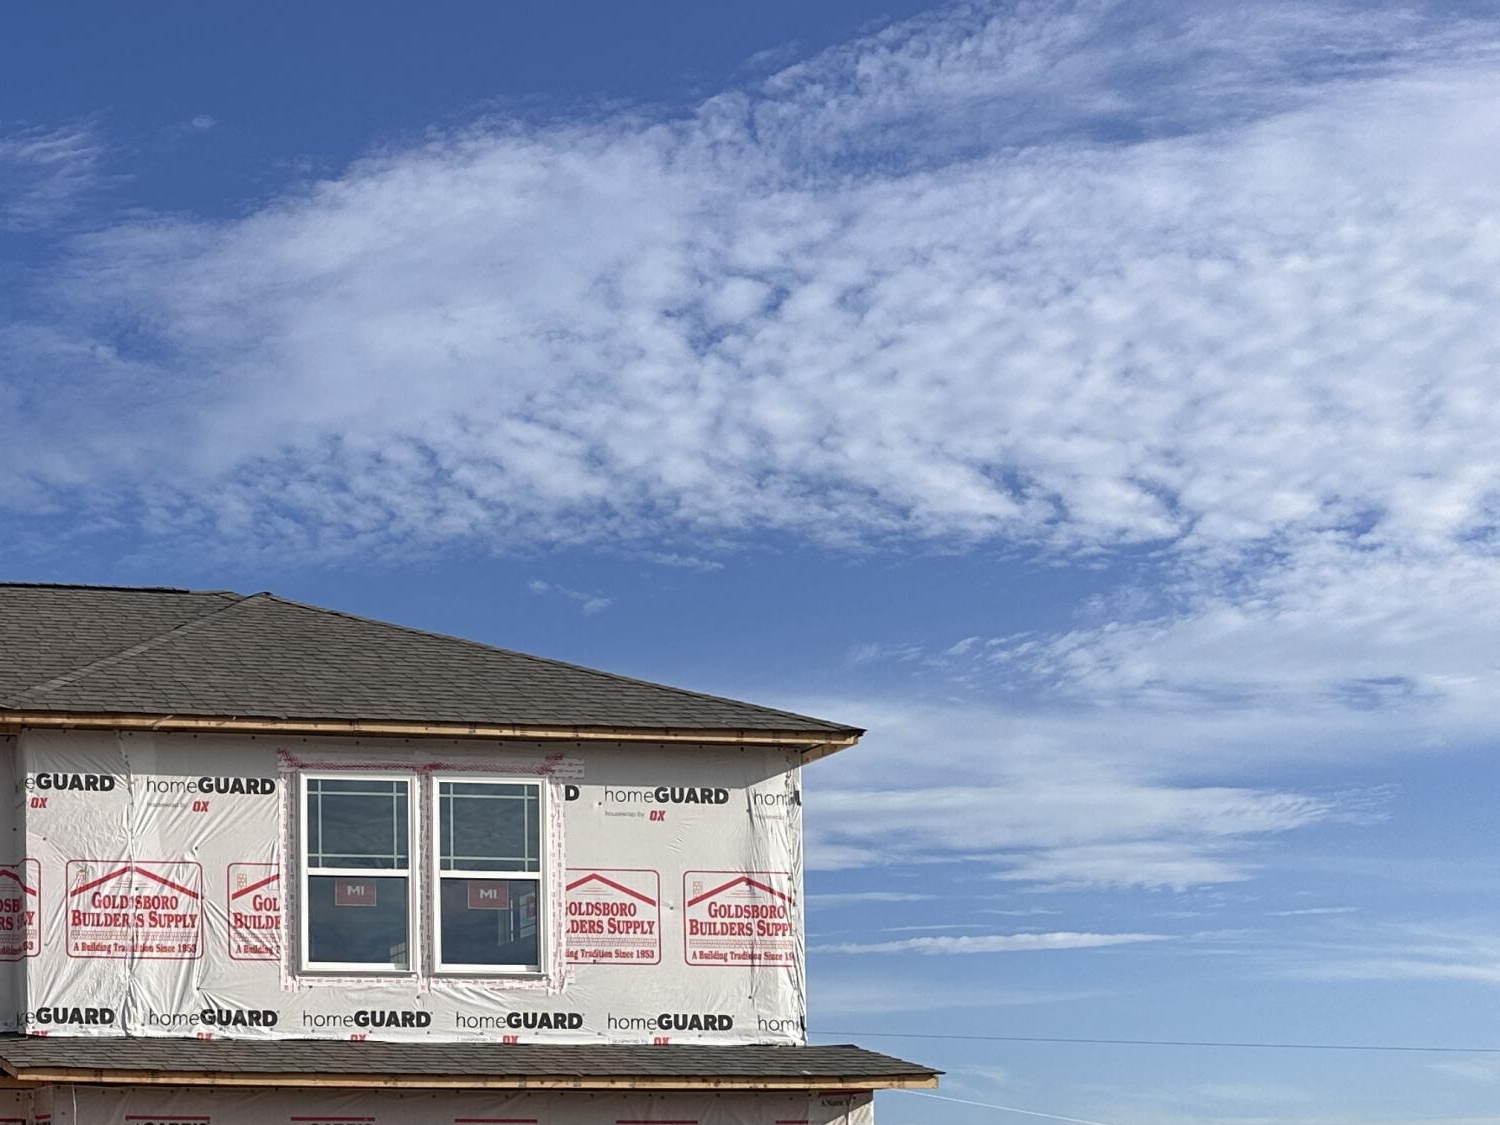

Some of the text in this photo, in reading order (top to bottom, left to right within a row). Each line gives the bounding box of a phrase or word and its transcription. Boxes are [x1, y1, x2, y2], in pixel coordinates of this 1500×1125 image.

[147, 777, 276, 795] homeGUARD
[30, 797, 48, 809] OX
[605, 786, 729, 804] homeGUARD
[192, 801, 210, 813] OX
[649, 810, 666, 821] OX
[347, 885, 365, 896] MI
[479, 888, 497, 899] MI
[566, 901, 637, 917] OLDSBORO
[708, 901, 785, 919] GOLDSBORO
[149, 911, 198, 929] SUPPLY
[608, 919, 655, 935] SUPPLY
[689, 920, 754, 936] BUILDERS
[81, 942, 111, 954] Building
[156, 944, 175, 953] Since
[581, 950, 655, 960] Tradition Since 1953
[699, 951, 728, 962] Building
[150, 1008, 278, 1027] homeGUARD
[303, 1010, 432, 1028] homeGUARD
[456, 1011, 583, 1029] homeGUARD
[608, 1013, 733, 1031] homeGUARD
